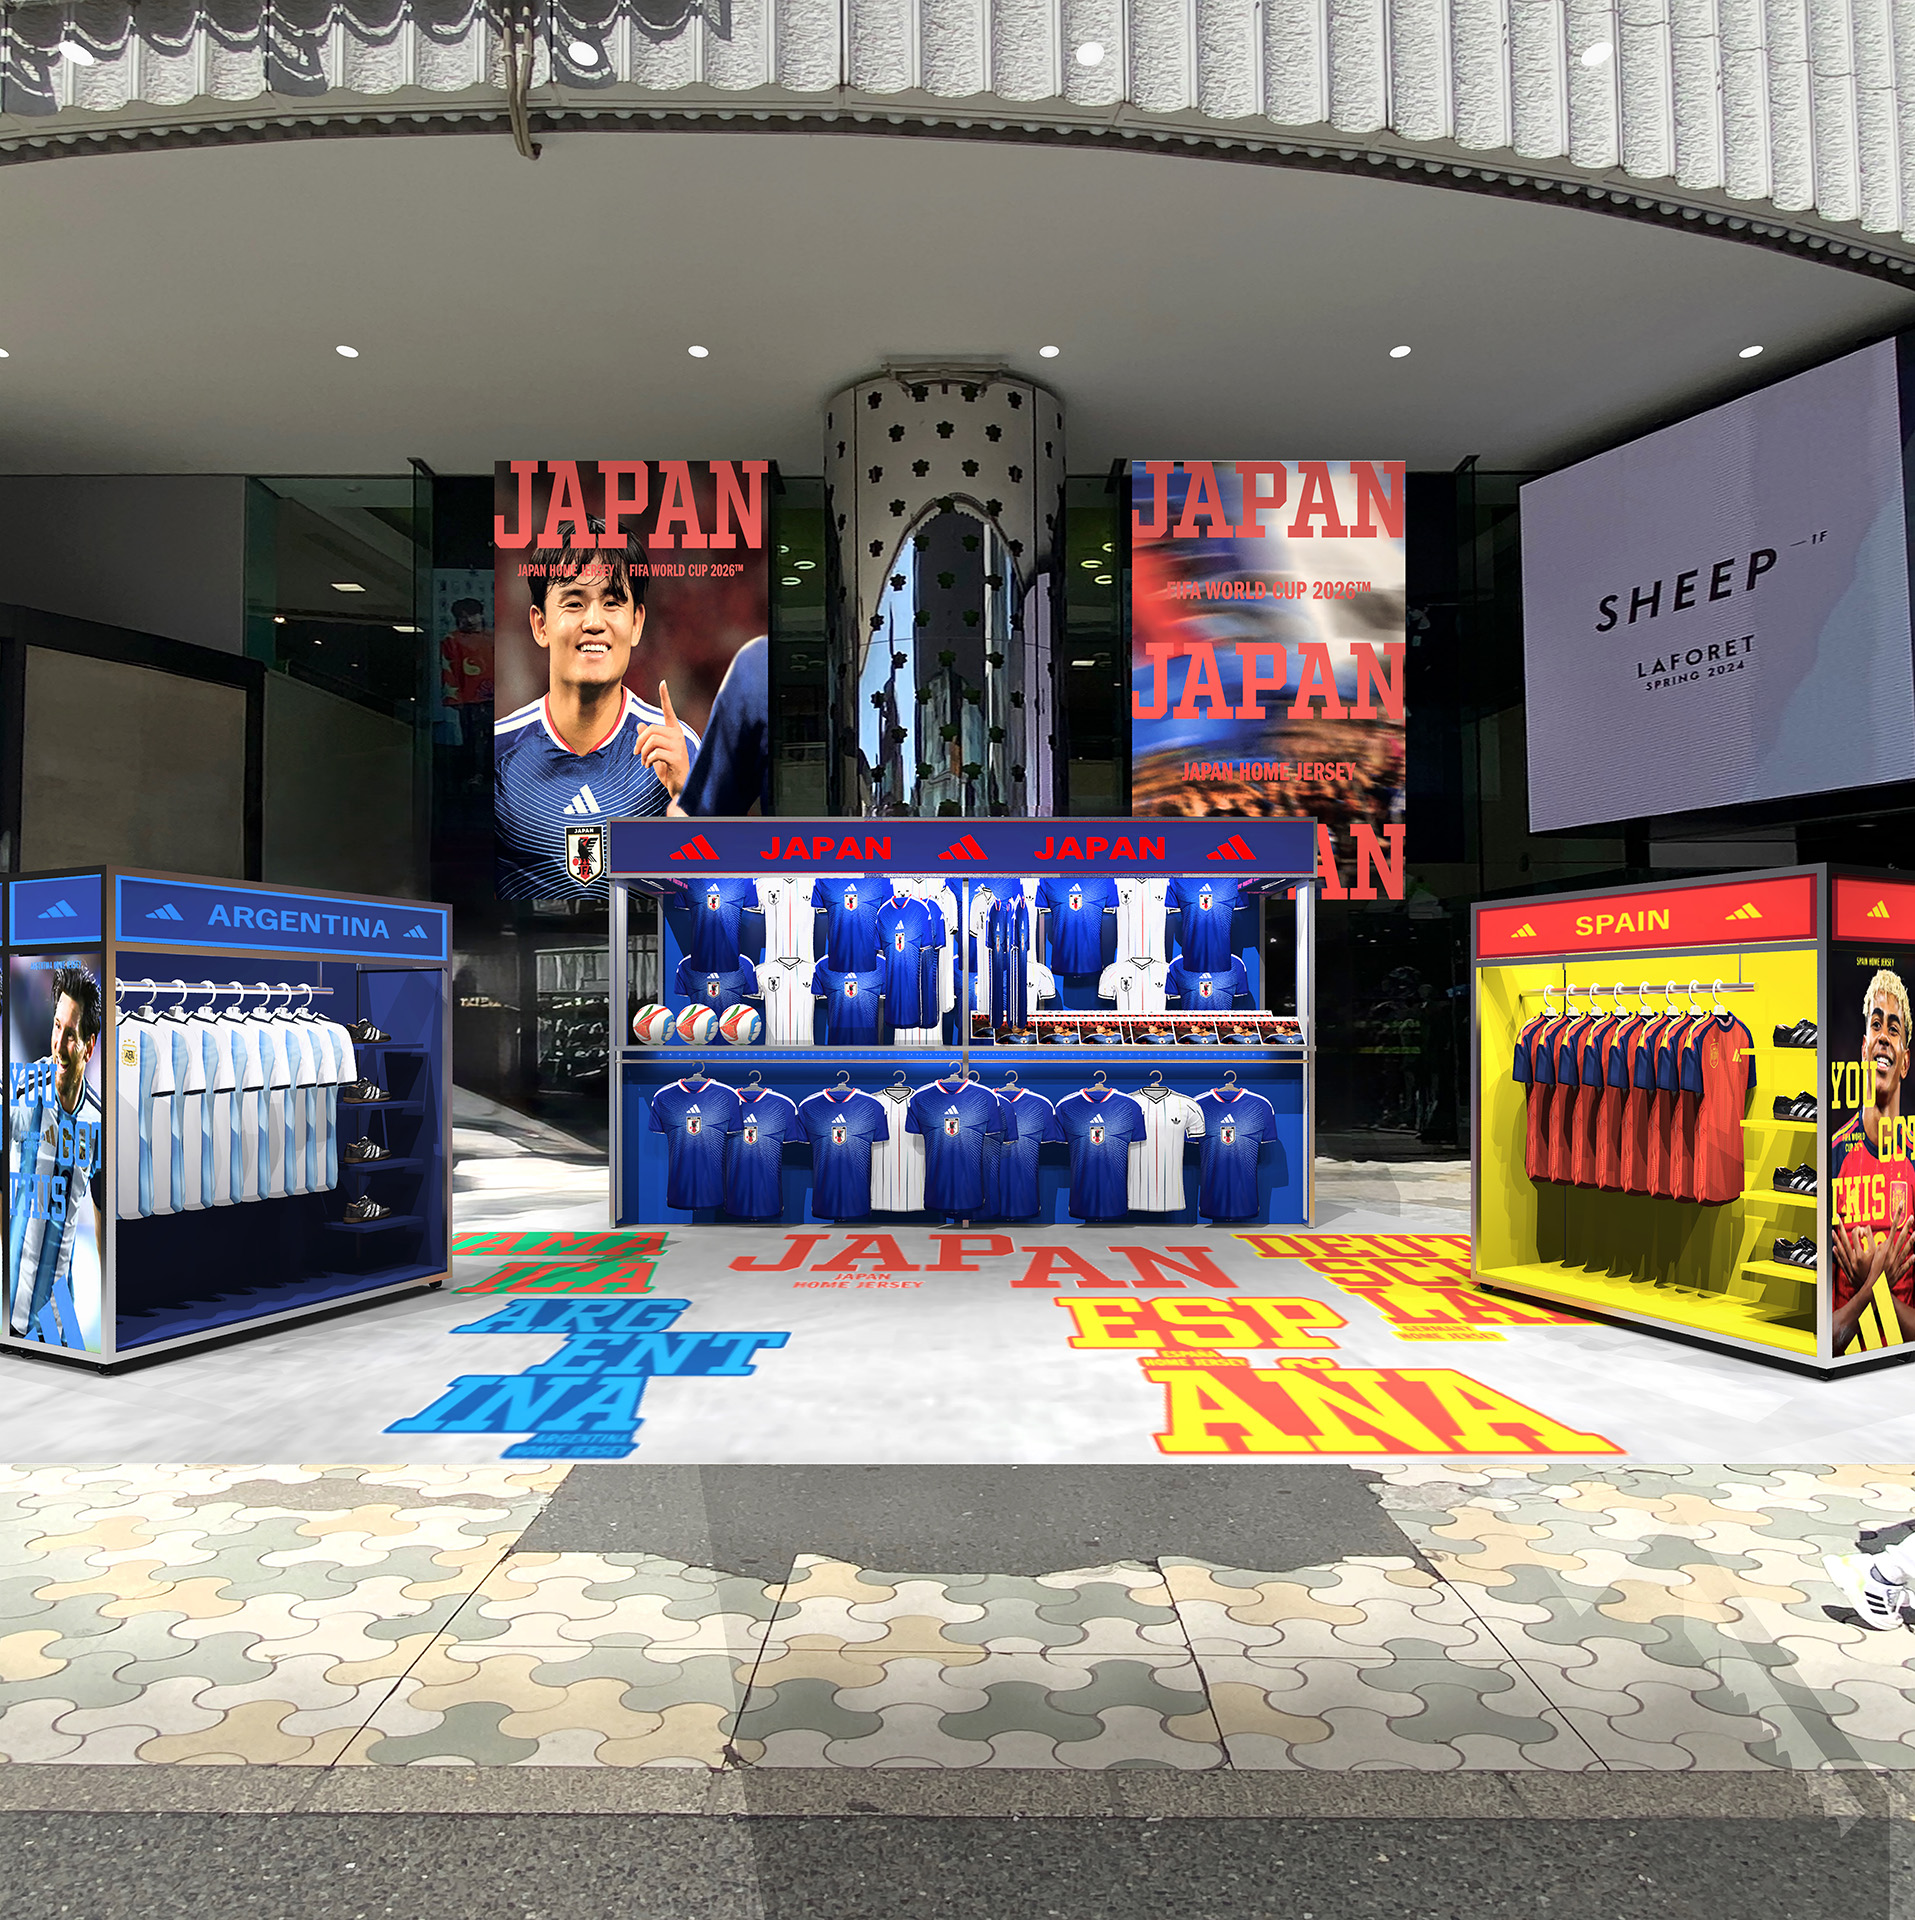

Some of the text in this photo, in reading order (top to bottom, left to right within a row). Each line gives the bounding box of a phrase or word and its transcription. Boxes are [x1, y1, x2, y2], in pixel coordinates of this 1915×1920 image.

[495, 460, 769, 549] JAPAN
[1132, 461, 1405, 538] JAPAN
[517, 563, 615, 577] JAPAN HOME JERSEY
[629, 563, 649, 577] FIFA
[650, 563, 685, 577] WORLD
[688, 563, 708, 577] CUP
[1167, 581, 1202, 600] FIFA
[1205, 581, 1266, 600] WORLD
[1272, 581, 1307, 600] CUP
[1595, 547, 1778, 632] SHEEP
[1637, 634, 1755, 679] LAFORET
[1132, 642, 1405, 720] JAPAN
[1645, 660, 1745, 691] SPRING 2024
[1181, 761, 1356, 781] JAPAN HOME JERSEY
[760, 836, 892, 860] JAPAN
[1034, 836, 1165, 860] JAPAN
[577, 866, 593, 875] JFA
[207, 903, 390, 940] ARGENTINA
[1575, 908, 1670, 936] SPAIN
[1856, 956, 1868, 966] SPAIN
[1880, 957, 1895, 967] JERSEY
[10, 1062, 57, 1109] YOU
[1832, 1061, 1878, 1109] YOU
[10, 1172, 67, 1222] THIS
[1832, 1174, 1885, 1225] THIS
[452, 1261, 658, 1294] ICA
[728, 1234, 1240, 1289] JAPAN
[793, 1281, 924, 1289] HOME JERSEY
[450, 1299, 692, 1333] ARG
[1055, 1297, 1347, 1349] ESP
[522, 1332, 790, 1375] ENT
[1143, 1358, 1248, 1367] HOME JERSEY
[384, 1375, 649, 1433] INA
[1152, 1357, 1623, 1453] AÑA
[509, 1445, 629, 1456] HOME JERSEY
[533, 1433, 631, 1444] ARGENTINA
